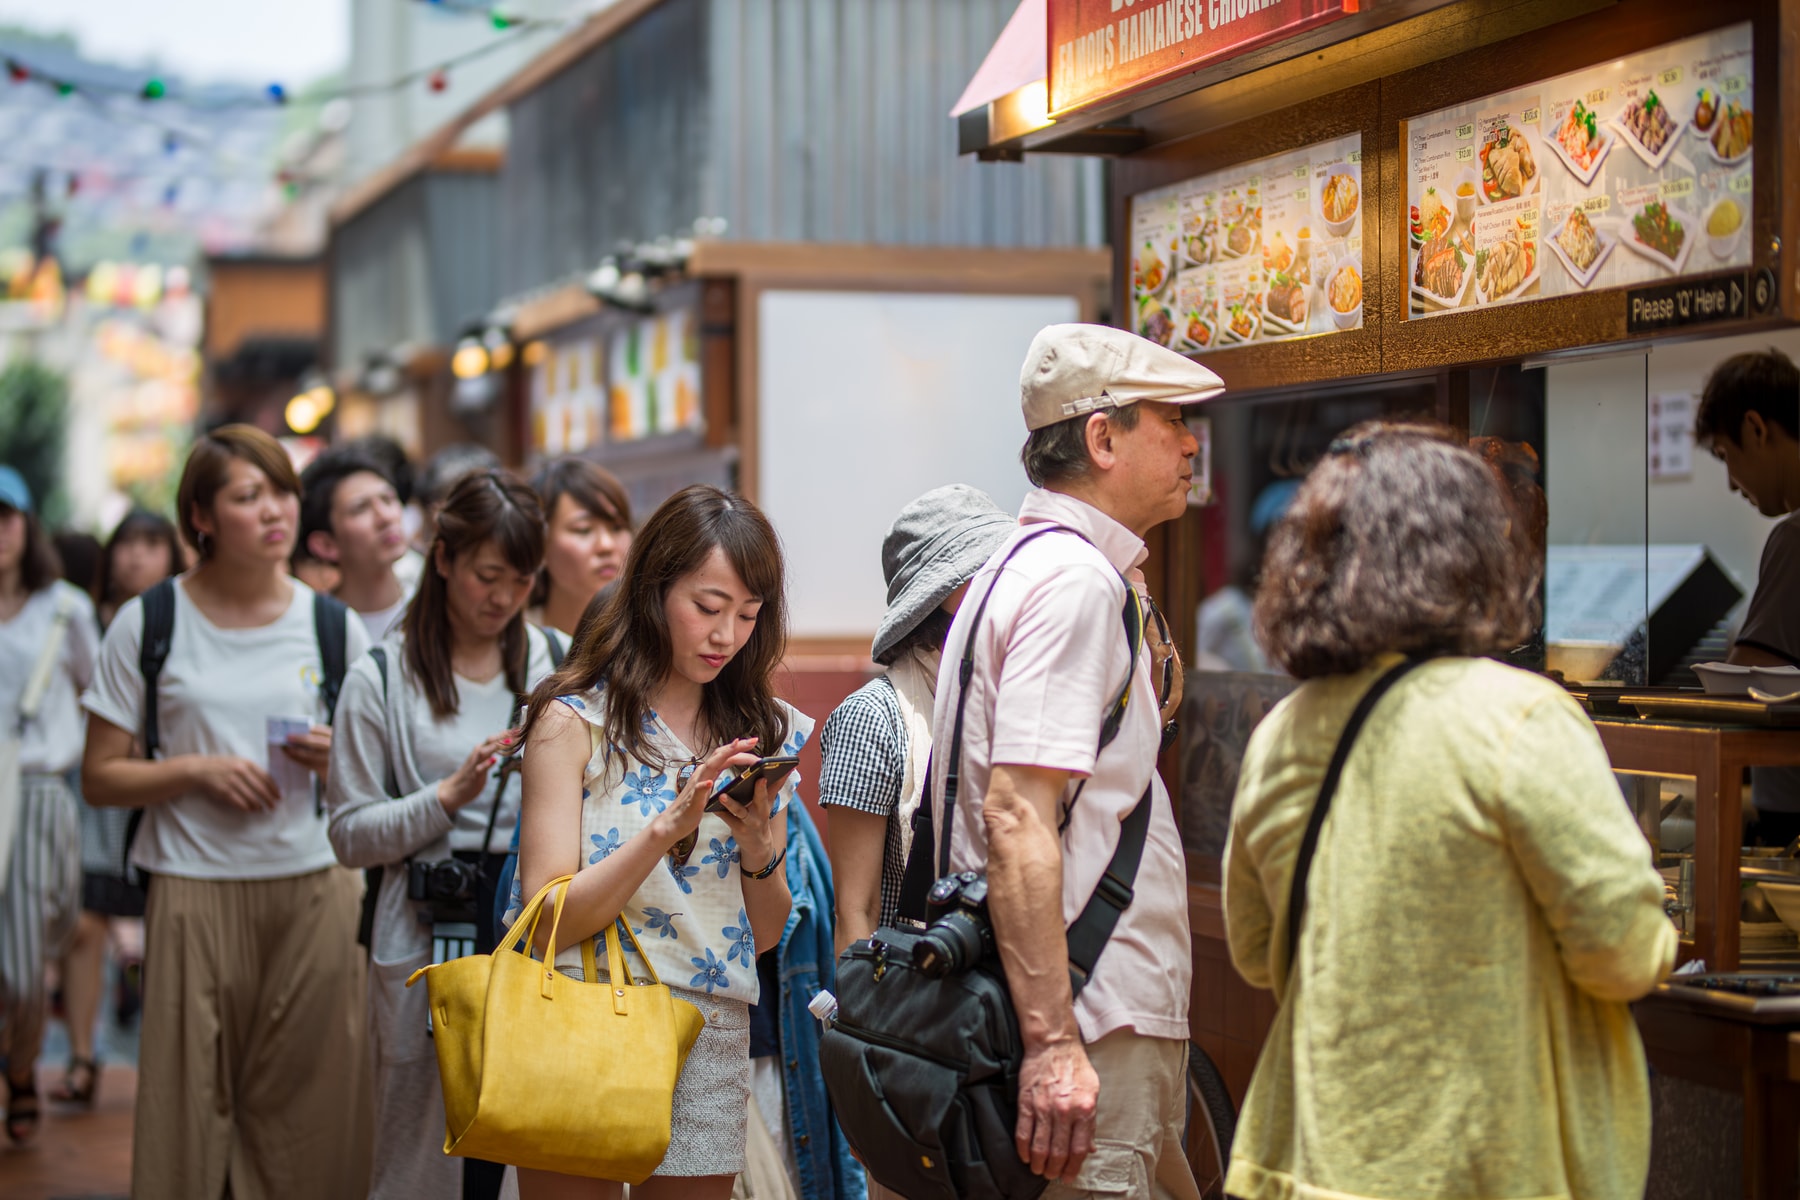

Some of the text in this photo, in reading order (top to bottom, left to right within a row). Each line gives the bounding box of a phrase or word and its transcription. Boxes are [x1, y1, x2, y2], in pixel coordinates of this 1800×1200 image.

[1058, 24, 1114, 87] FAMOUS
[1118, 0, 1203, 64] HAINANESE
[1632, 297, 1674, 322] Please
[1694, 287, 1725, 314] Here
[1755, 278, 1768, 305] 6
